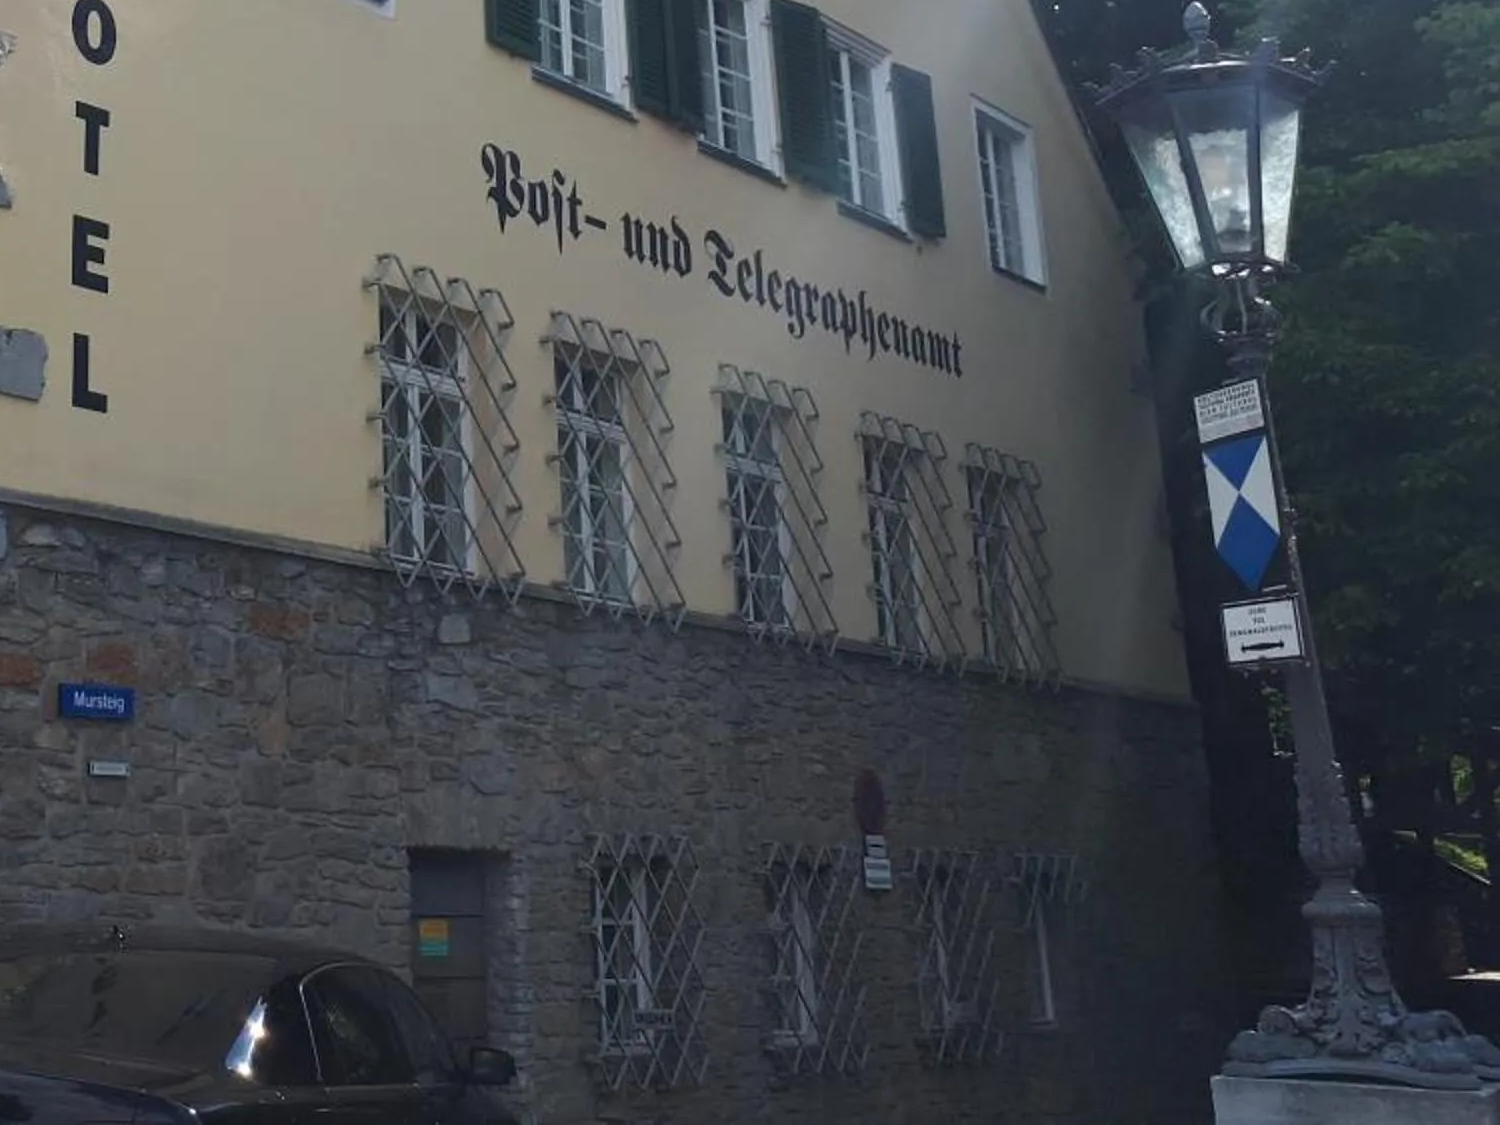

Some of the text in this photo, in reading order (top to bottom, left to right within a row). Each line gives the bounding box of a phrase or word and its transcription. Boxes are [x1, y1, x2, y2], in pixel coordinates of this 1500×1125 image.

[620, 211, 692, 277] und
[704, 230, 963, 378] Telegraphenamt
[74, 691, 125, 713] Mursteig
